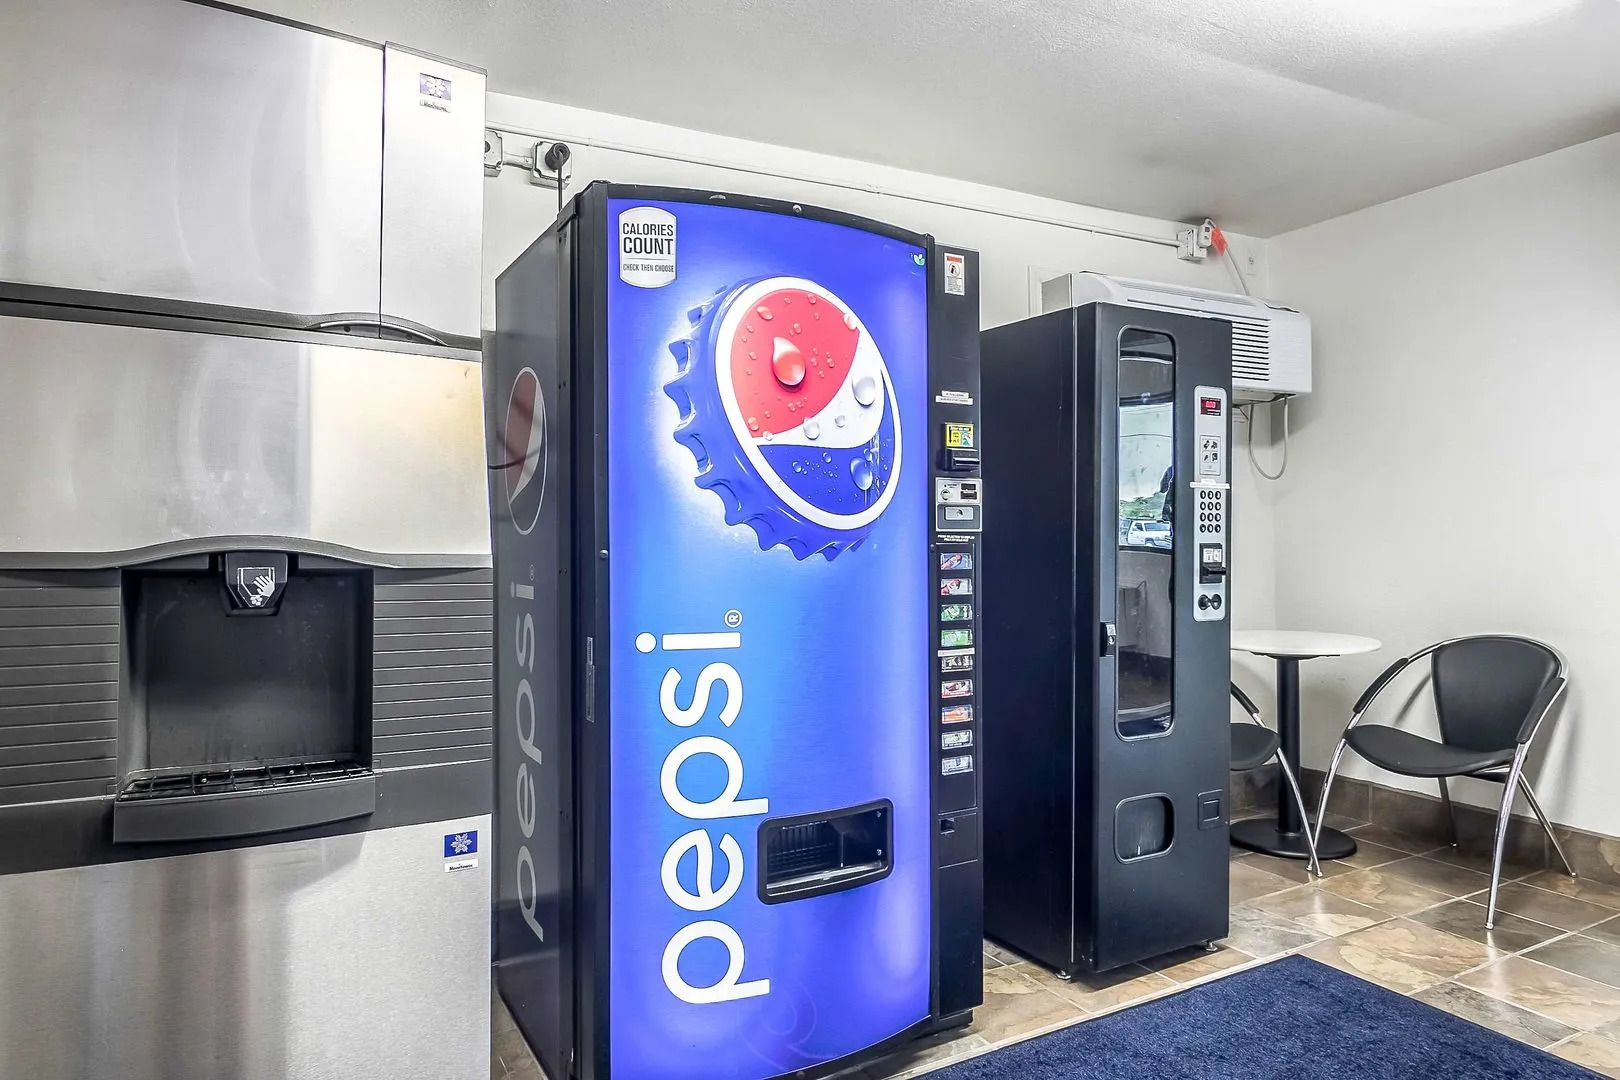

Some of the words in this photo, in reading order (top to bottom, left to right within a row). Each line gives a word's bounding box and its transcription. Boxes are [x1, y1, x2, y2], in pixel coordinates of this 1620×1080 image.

[622, 222, 674, 236] CALORIES
[623, 236, 674, 255] COUNT
[622, 263, 640, 272] CHECK
[640, 263, 654, 272] THEN
[654, 264, 674, 273] CHOOSE
[511, 582, 544, 943] pepsi
[635, 631, 771, 1005] pepsi
